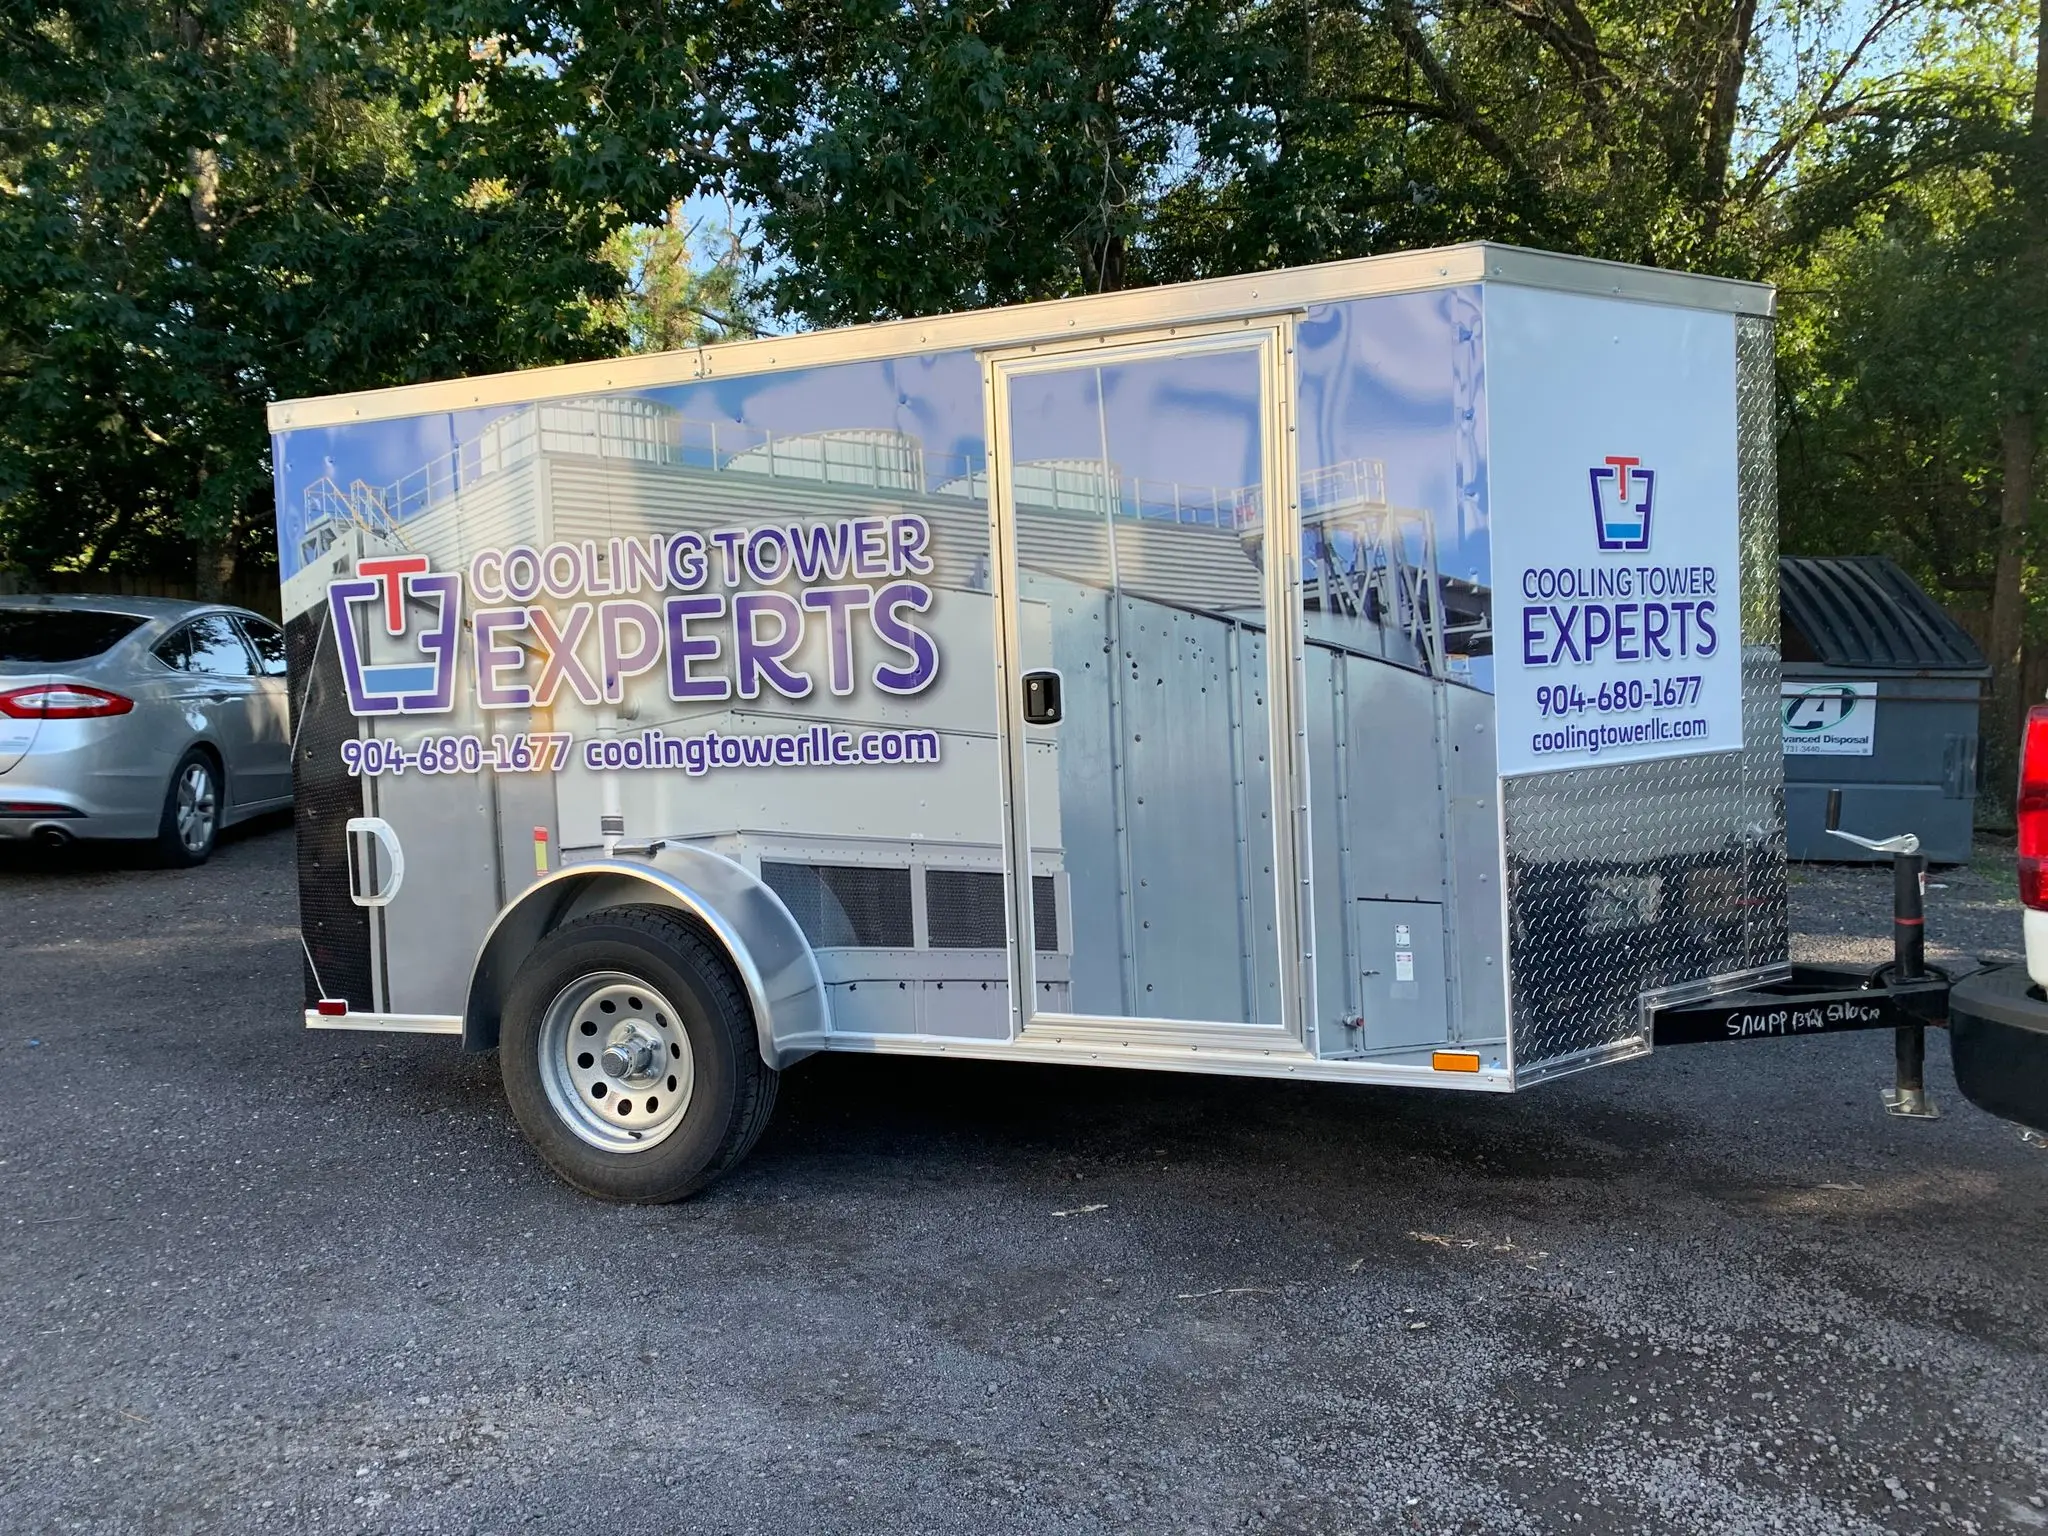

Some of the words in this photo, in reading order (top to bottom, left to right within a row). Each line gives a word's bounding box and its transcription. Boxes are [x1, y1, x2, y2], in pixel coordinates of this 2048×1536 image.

[472, 533, 706, 601] COOLING
[716, 516, 932, 583] TOWER
[1522, 567, 1632, 598] COOLING
[1636, 566, 1716, 595] TOWER
[474, 584, 937, 706] EXPERTS
[1523, 601, 1717, 665] EXPERTS
[1536, 675, 1702, 716] 904-680-1677
[342, 735, 570, 775] 904-680-1677
[586, 728, 937, 773] coolingtowerllc.com
[1532, 718, 1707, 752] coolingtowerllc.com
[1783, 735, 1820, 744] vanced
[1823, 734, 1869, 746] Disposal
